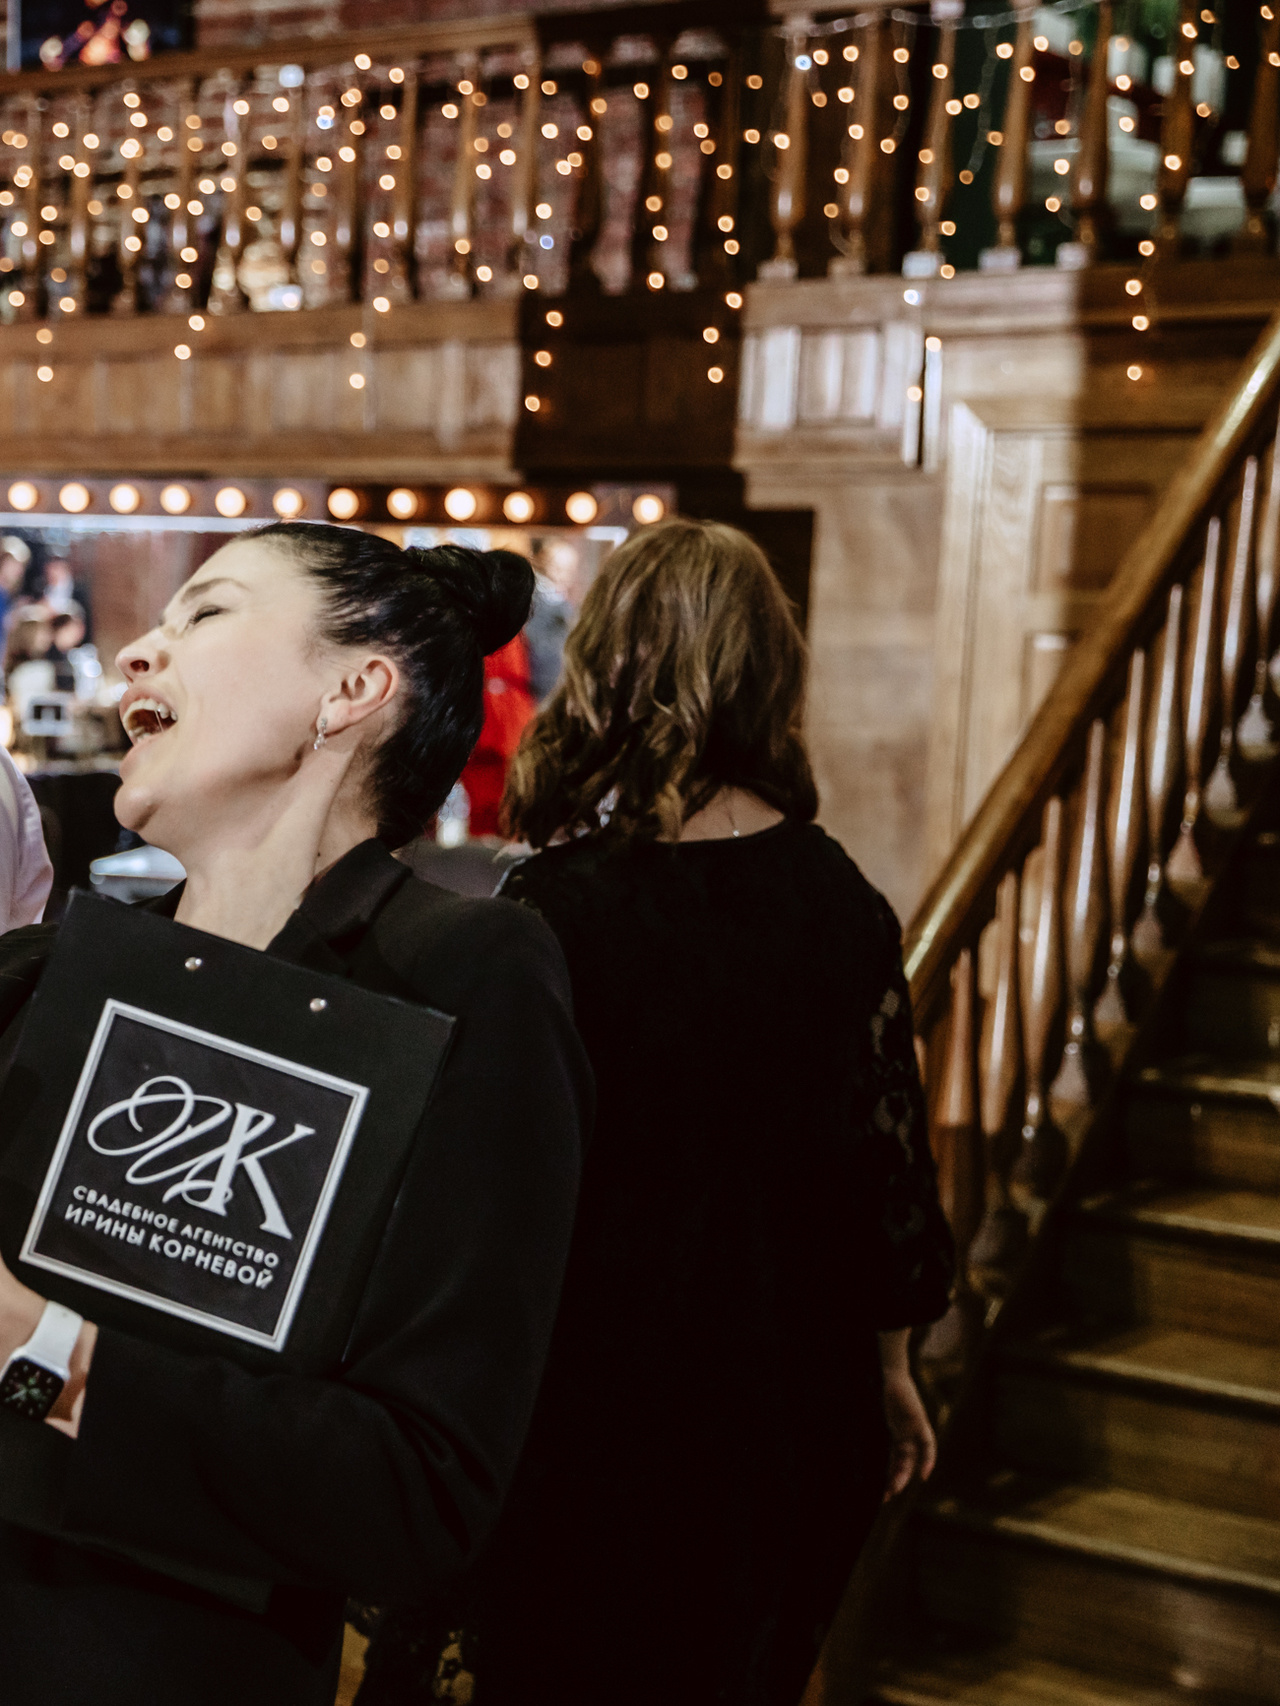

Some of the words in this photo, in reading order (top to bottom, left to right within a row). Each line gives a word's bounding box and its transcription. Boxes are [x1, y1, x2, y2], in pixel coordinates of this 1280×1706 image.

[64, 1203, 146, 1247] ИРИНЫ
[148, 1233, 274, 1290] КОРНЕВОЙ
[73, 1185, 180, 1234] СВАДЕБНОЕ
[180, 1224, 280, 1269] АГЕНТСТВО
